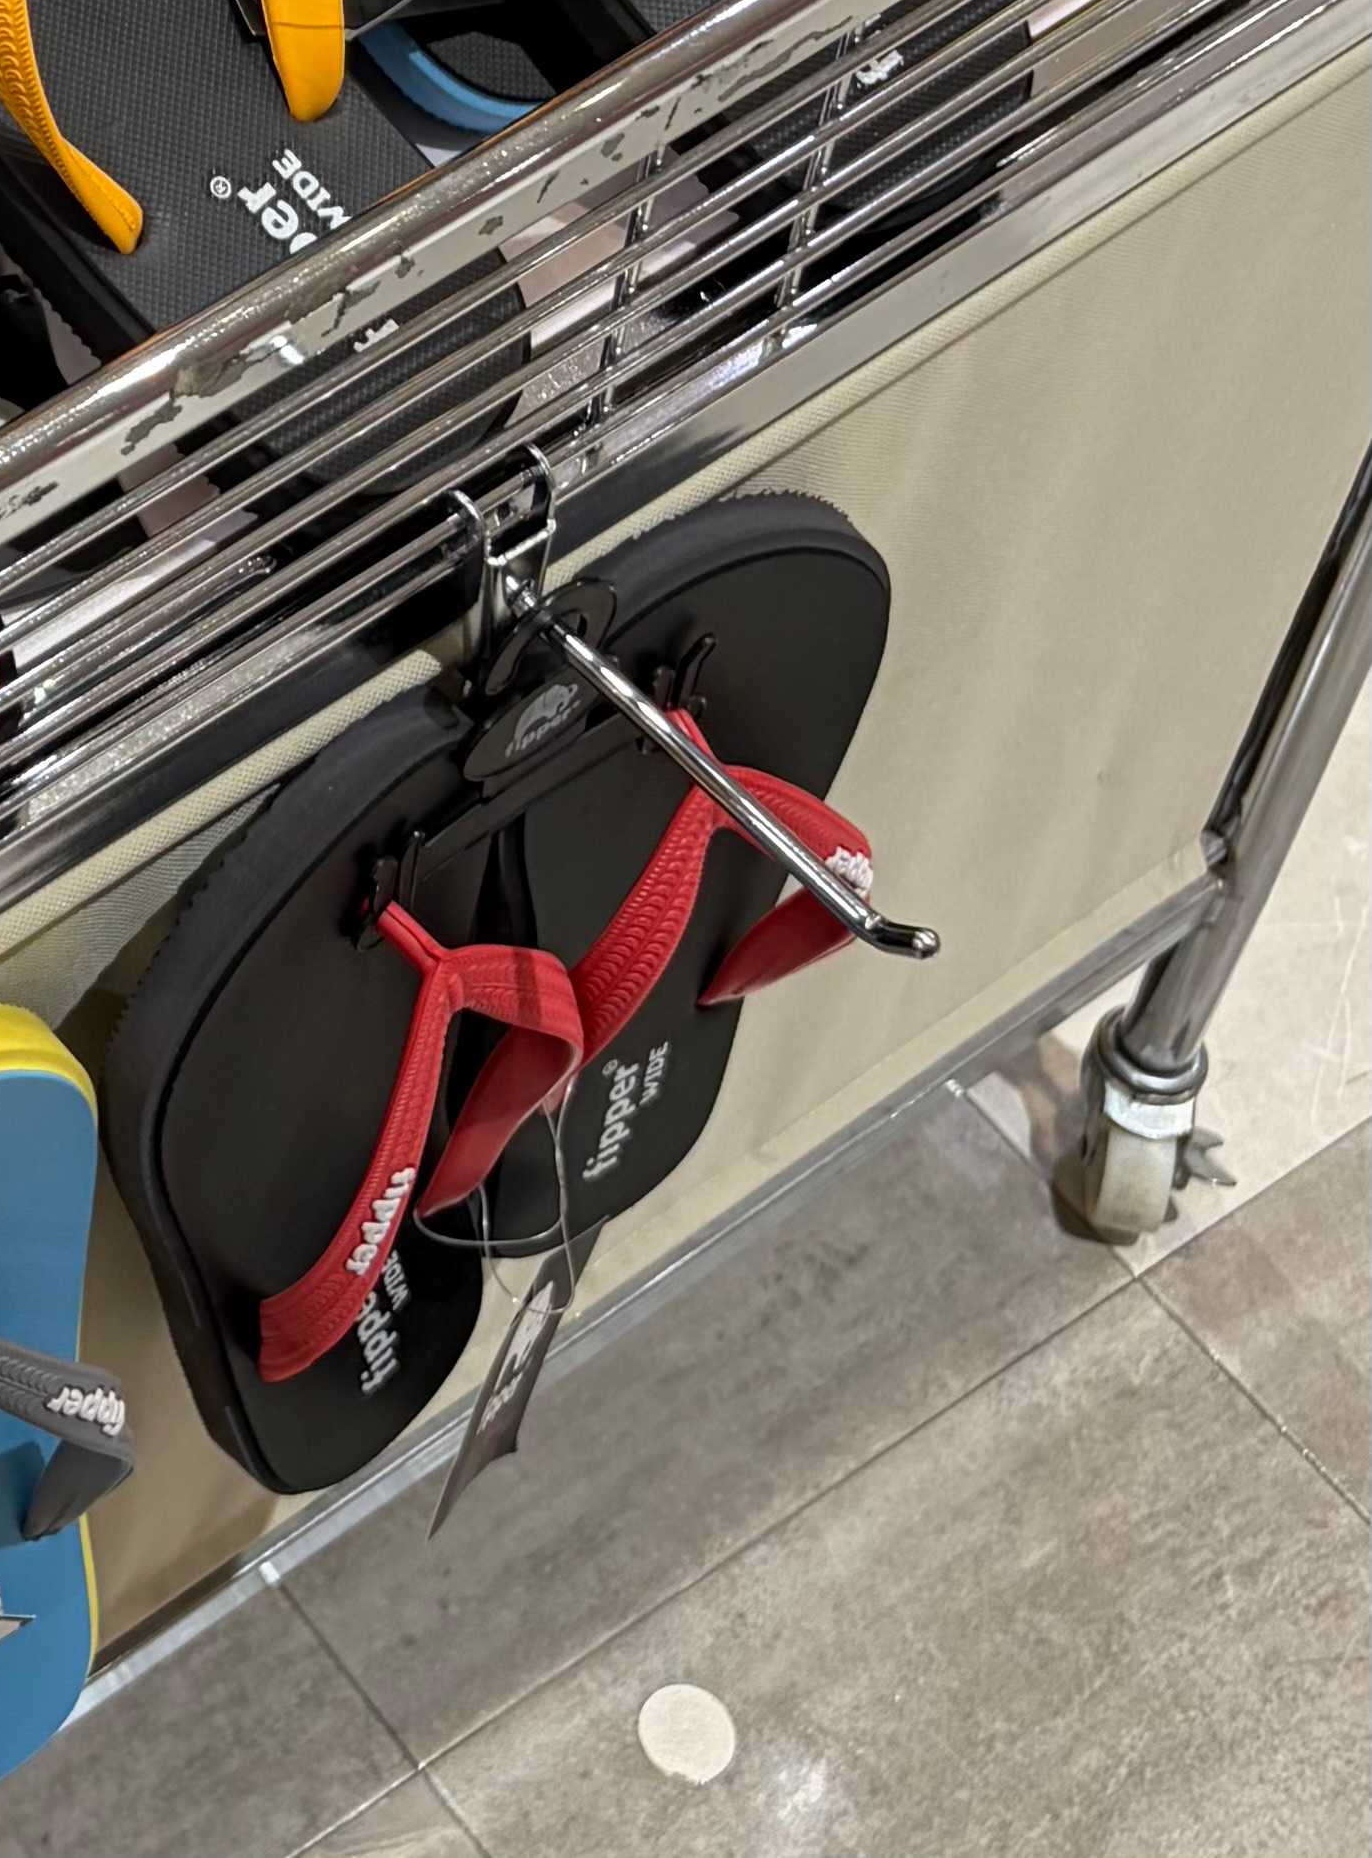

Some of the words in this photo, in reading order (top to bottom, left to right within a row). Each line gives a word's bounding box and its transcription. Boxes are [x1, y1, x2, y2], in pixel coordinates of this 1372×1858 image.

[583, 1063, 640, 1181] fipper
[639, 1042, 669, 1105] WIDE
[346, 1167, 416, 1276] fipper
